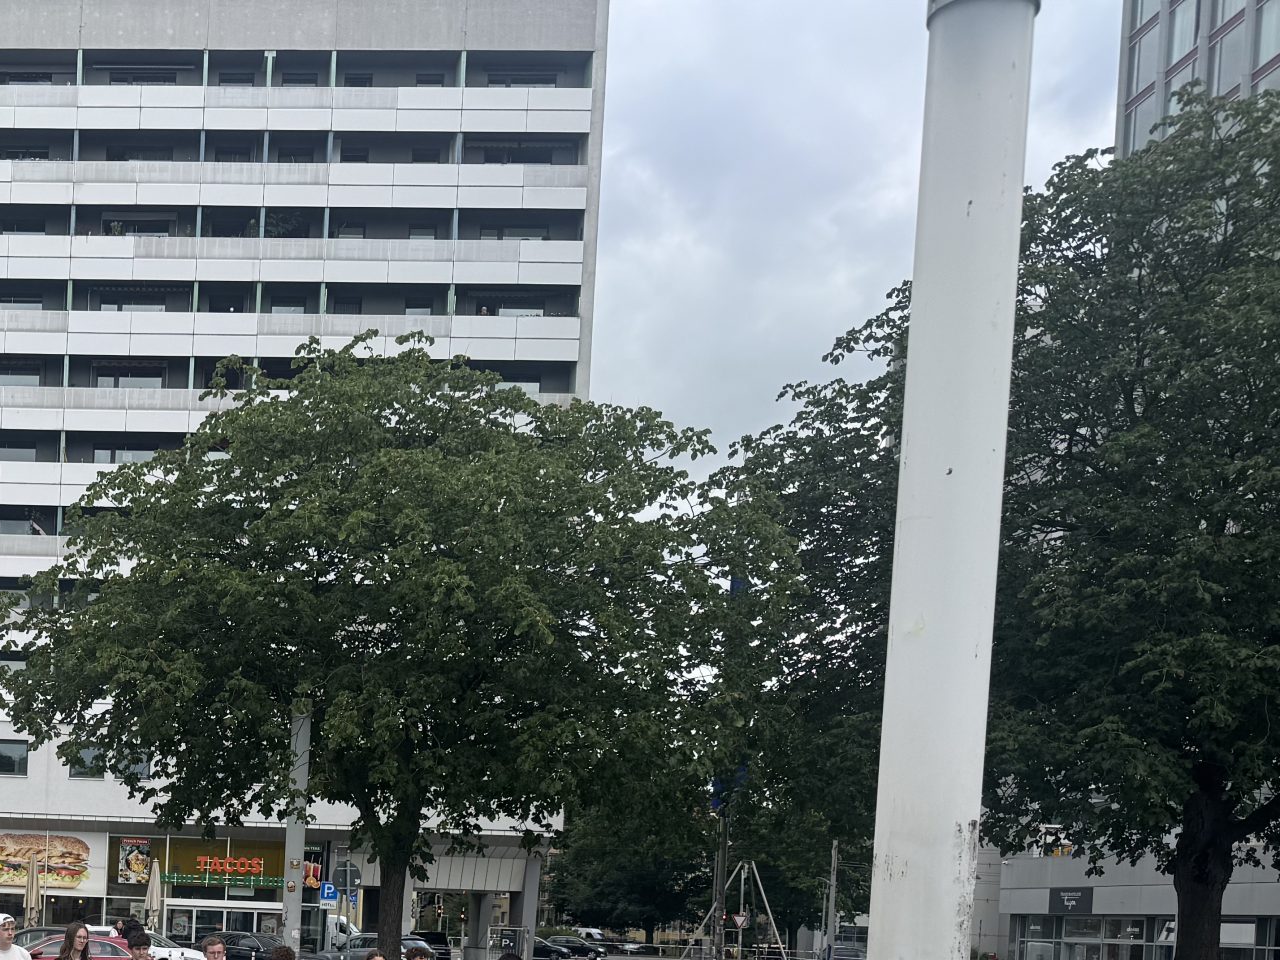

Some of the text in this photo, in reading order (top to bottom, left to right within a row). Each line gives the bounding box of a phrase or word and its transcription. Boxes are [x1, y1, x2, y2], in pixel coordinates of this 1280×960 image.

[197, 855, 262, 874] TACOS
[324, 884, 334, 897] P
[501, 938, 510, 948] P
